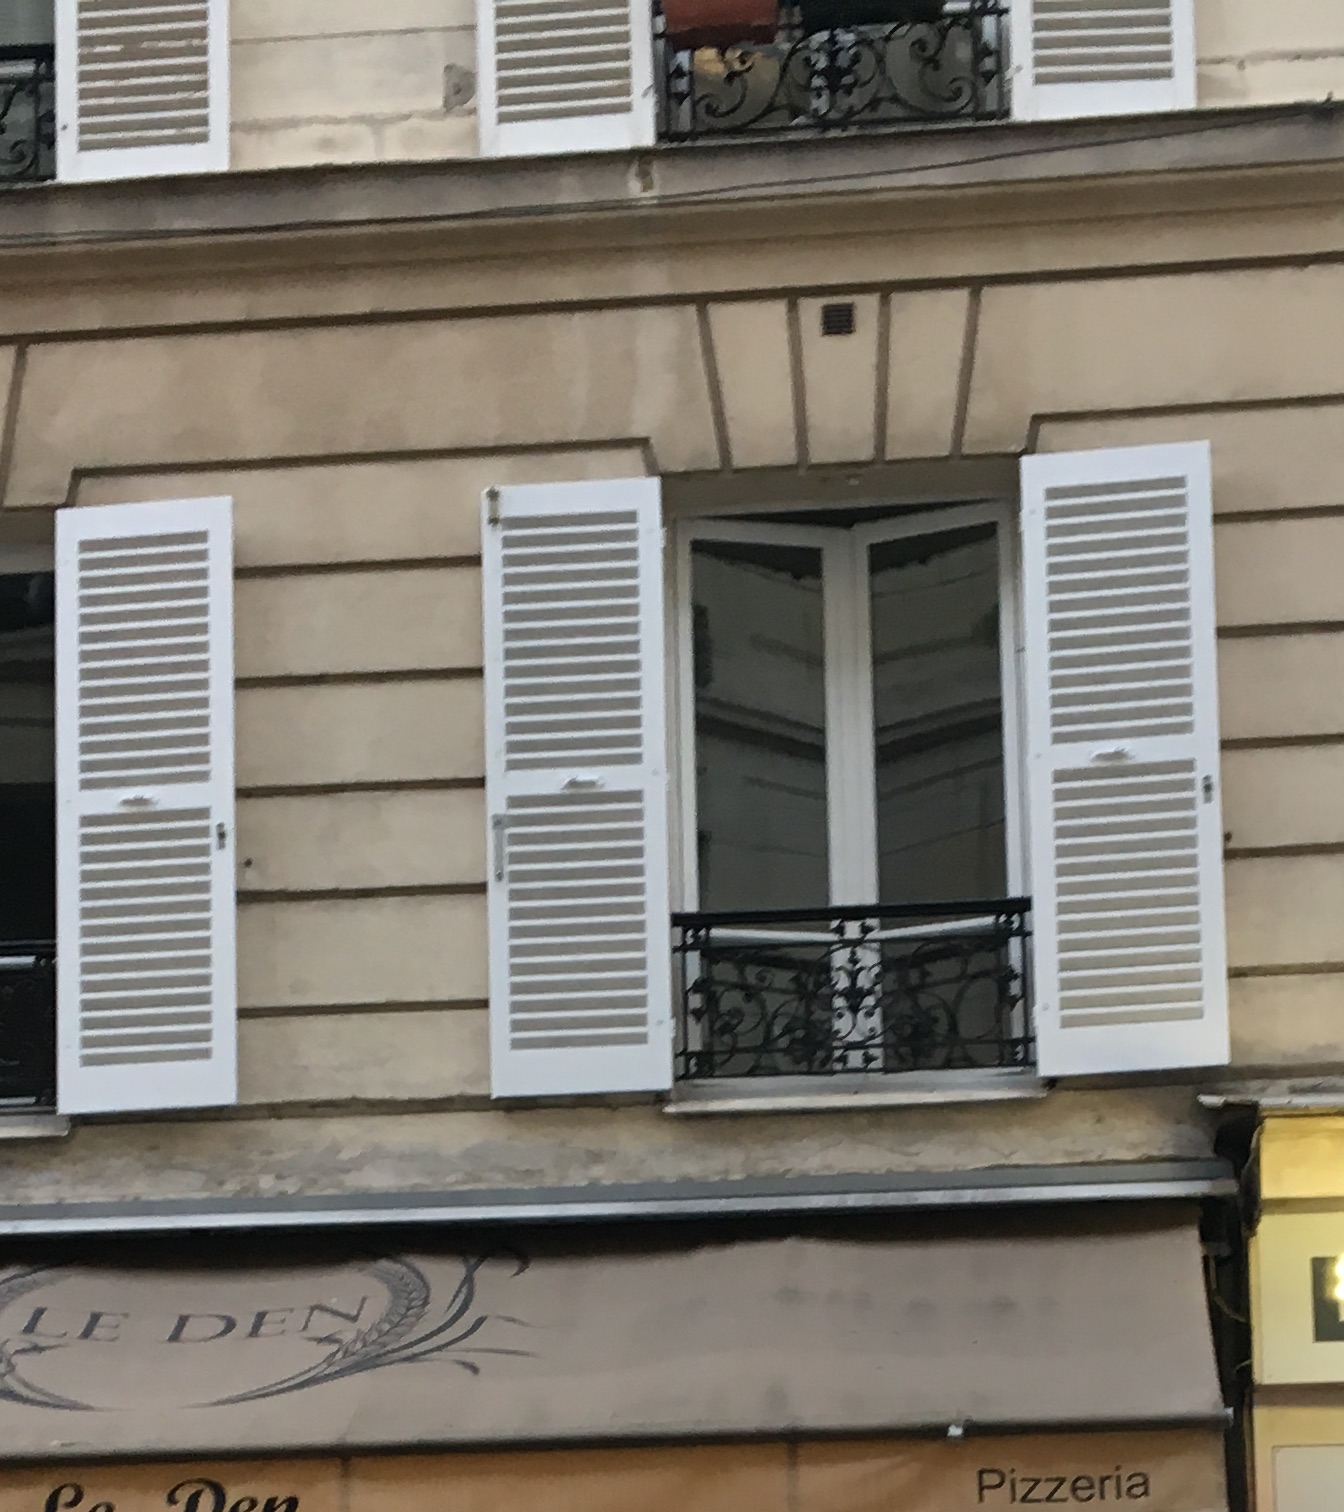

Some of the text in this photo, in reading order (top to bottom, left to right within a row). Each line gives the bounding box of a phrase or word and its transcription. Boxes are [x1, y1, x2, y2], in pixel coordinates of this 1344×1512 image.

[20, 1295, 371, 1344] LE DEN
[976, 1464, 1151, 1504] Pizzeria
